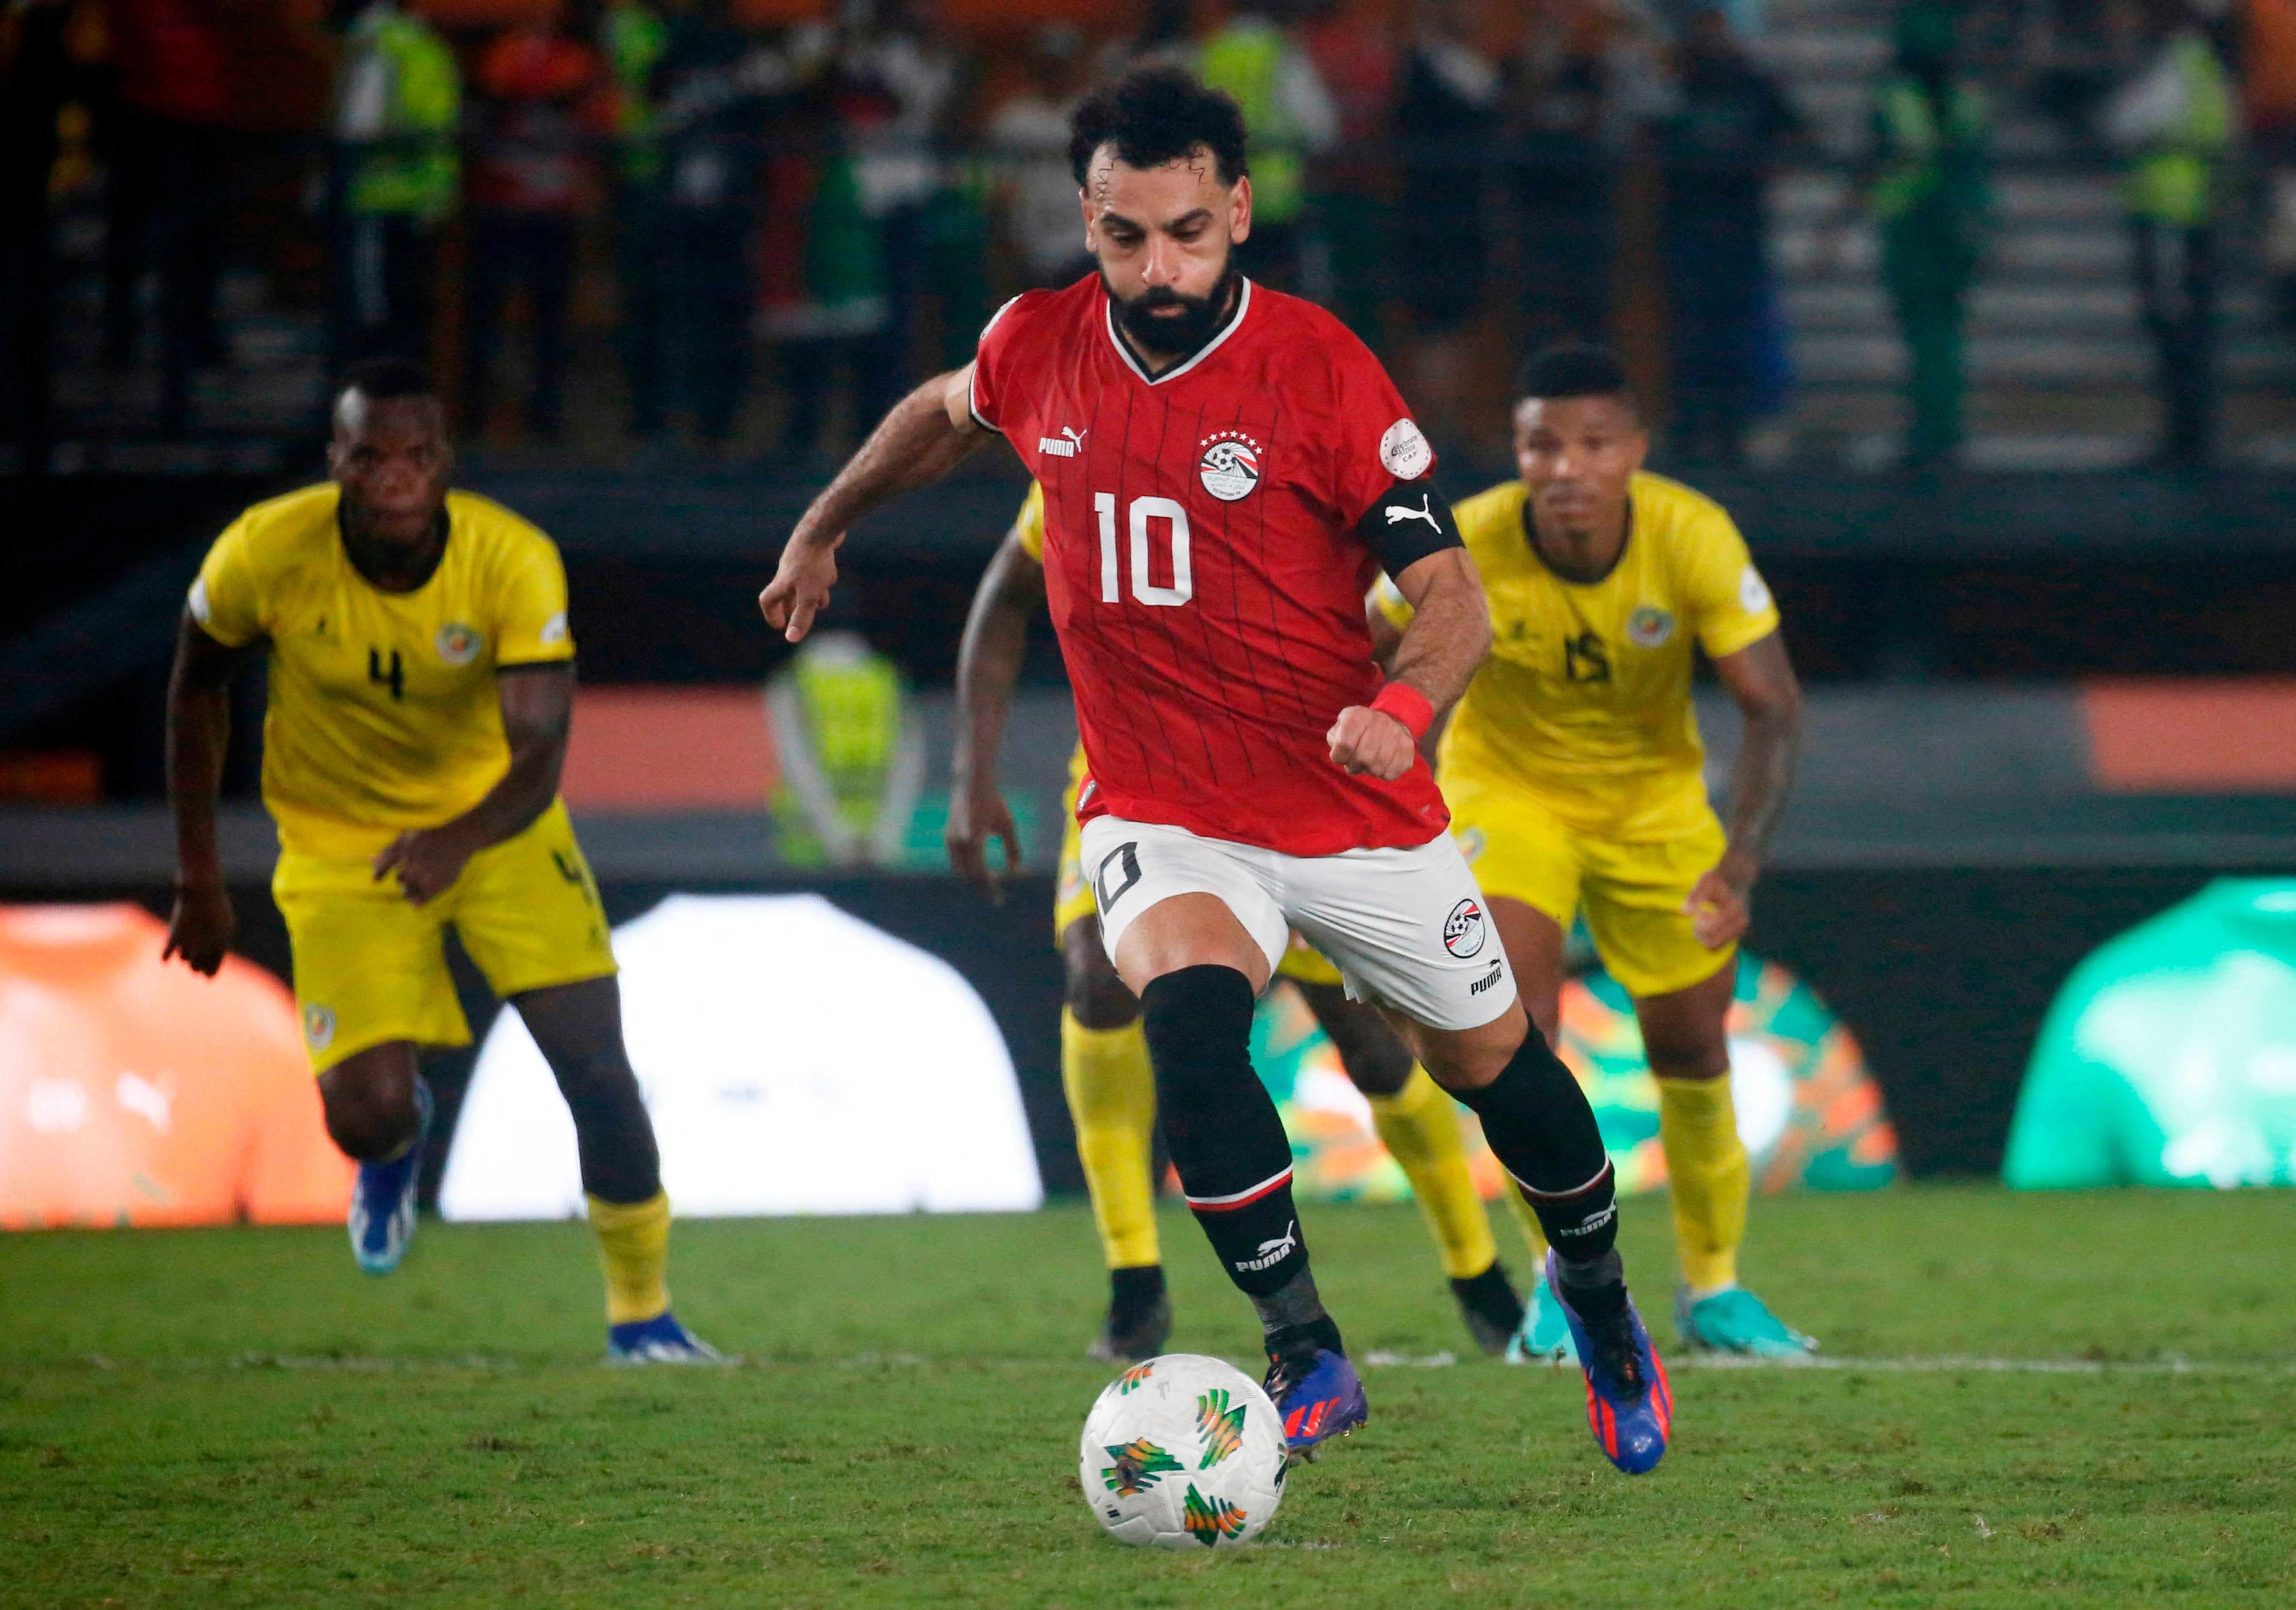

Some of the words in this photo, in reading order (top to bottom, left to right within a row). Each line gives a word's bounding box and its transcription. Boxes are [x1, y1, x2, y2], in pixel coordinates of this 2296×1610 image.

[1039, 437, 1074, 457] PUMA
[1403, 451, 1417, 462] CAF
[1095, 492, 1192, 606] 10
[1564, 628, 1611, 683] 15
[368, 647, 402, 699] 4
[1471, 966, 1502, 996] PUMA
[1560, 1211, 1611, 1236] PUMA
[1235, 1243, 1290, 1272] PUMA
